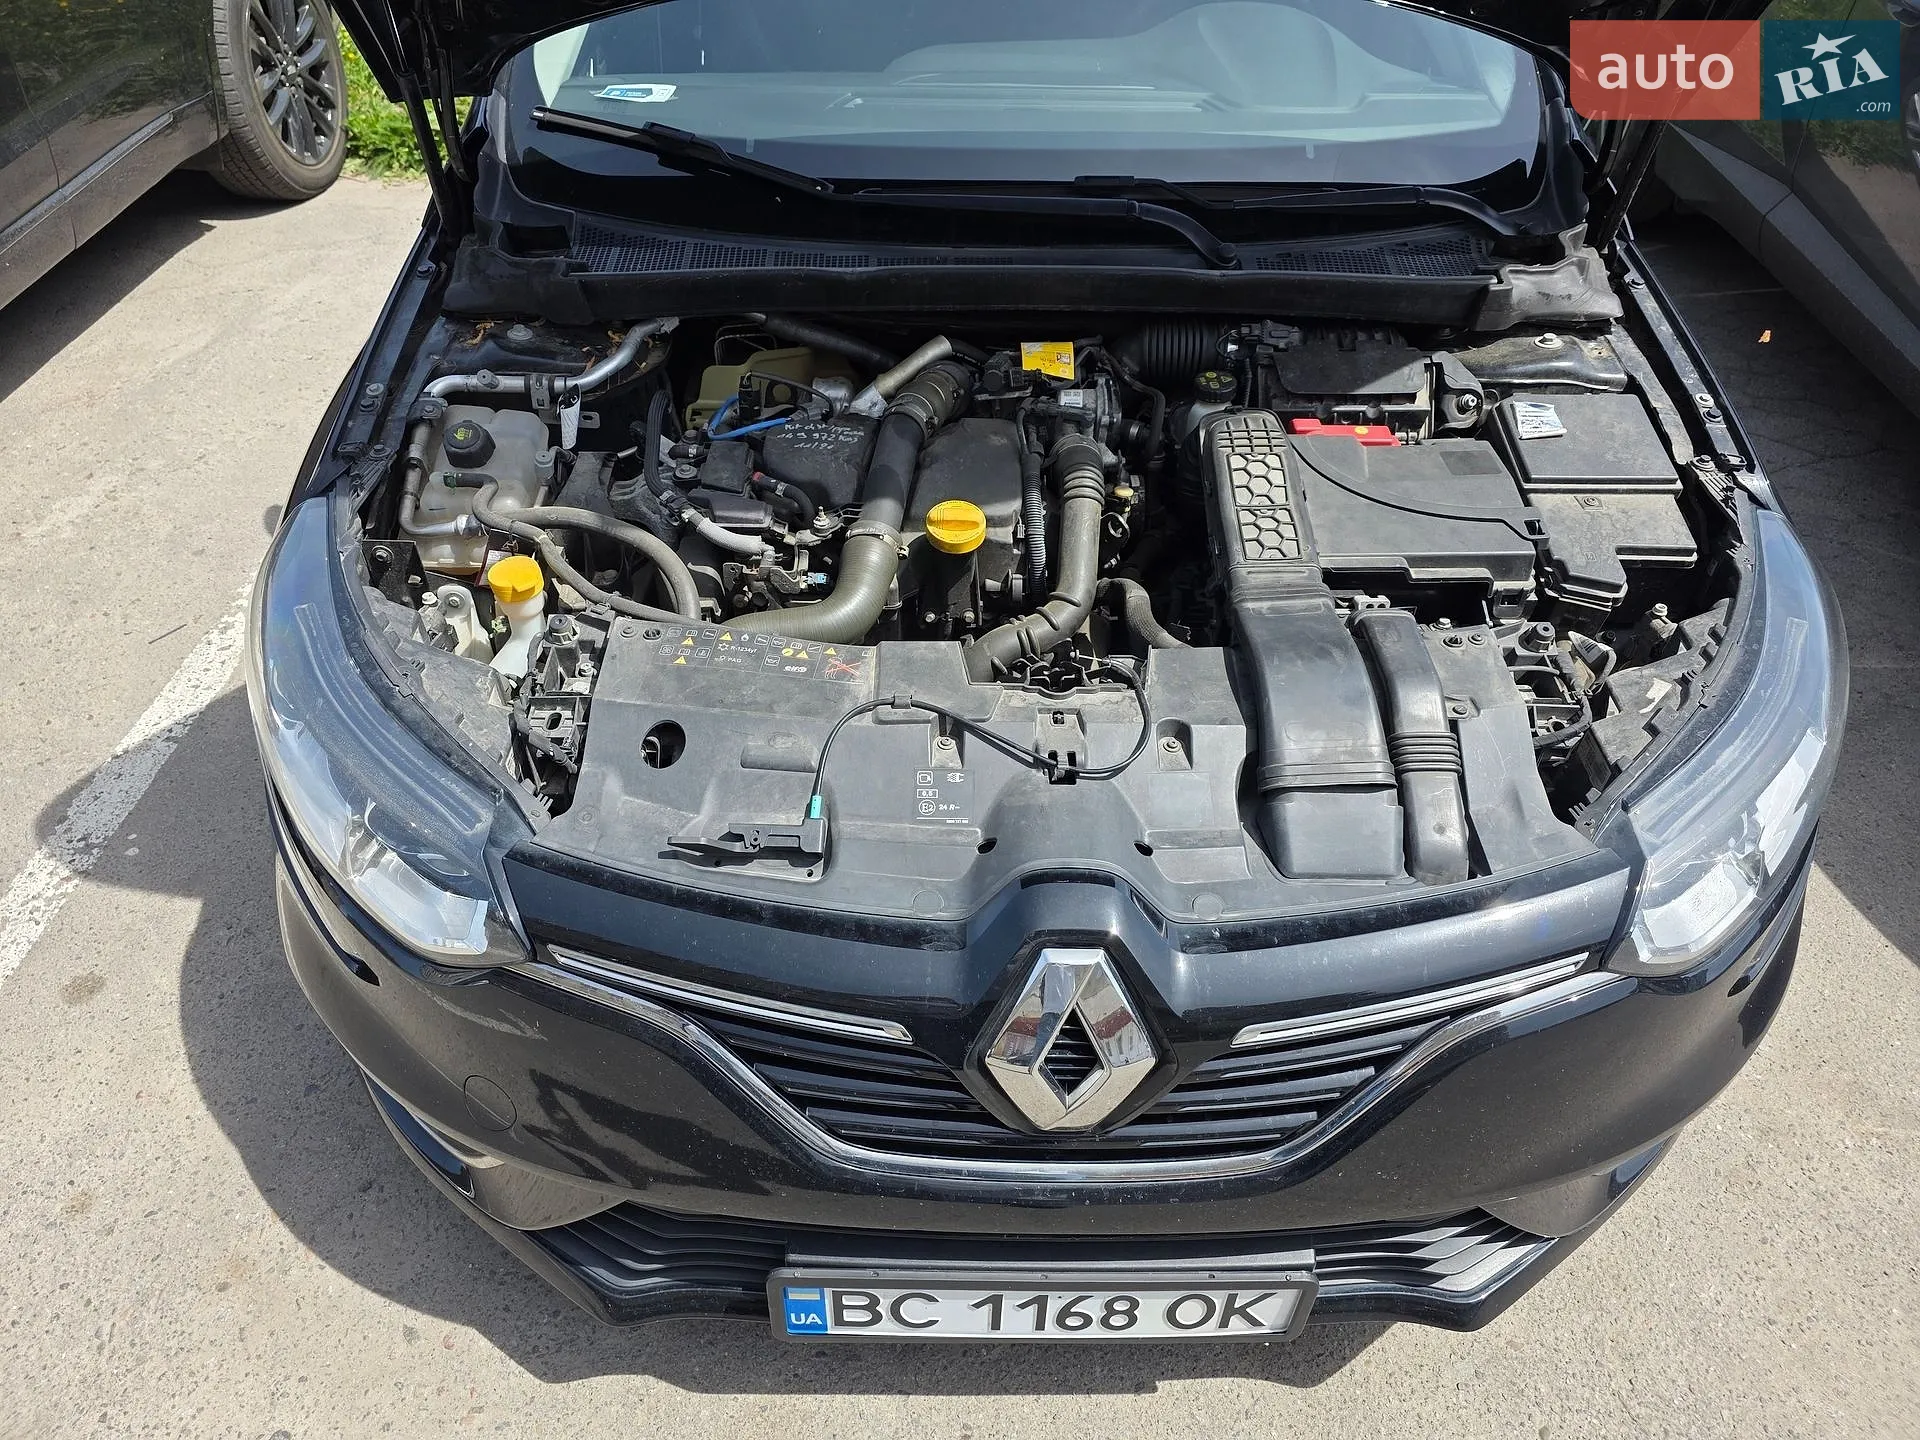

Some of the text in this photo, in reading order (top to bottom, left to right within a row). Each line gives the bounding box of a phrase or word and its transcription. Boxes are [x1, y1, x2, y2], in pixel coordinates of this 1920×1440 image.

[790, 1313, 823, 1325] UA
[831, 1290, 1278, 1332] BC 1168 OK
